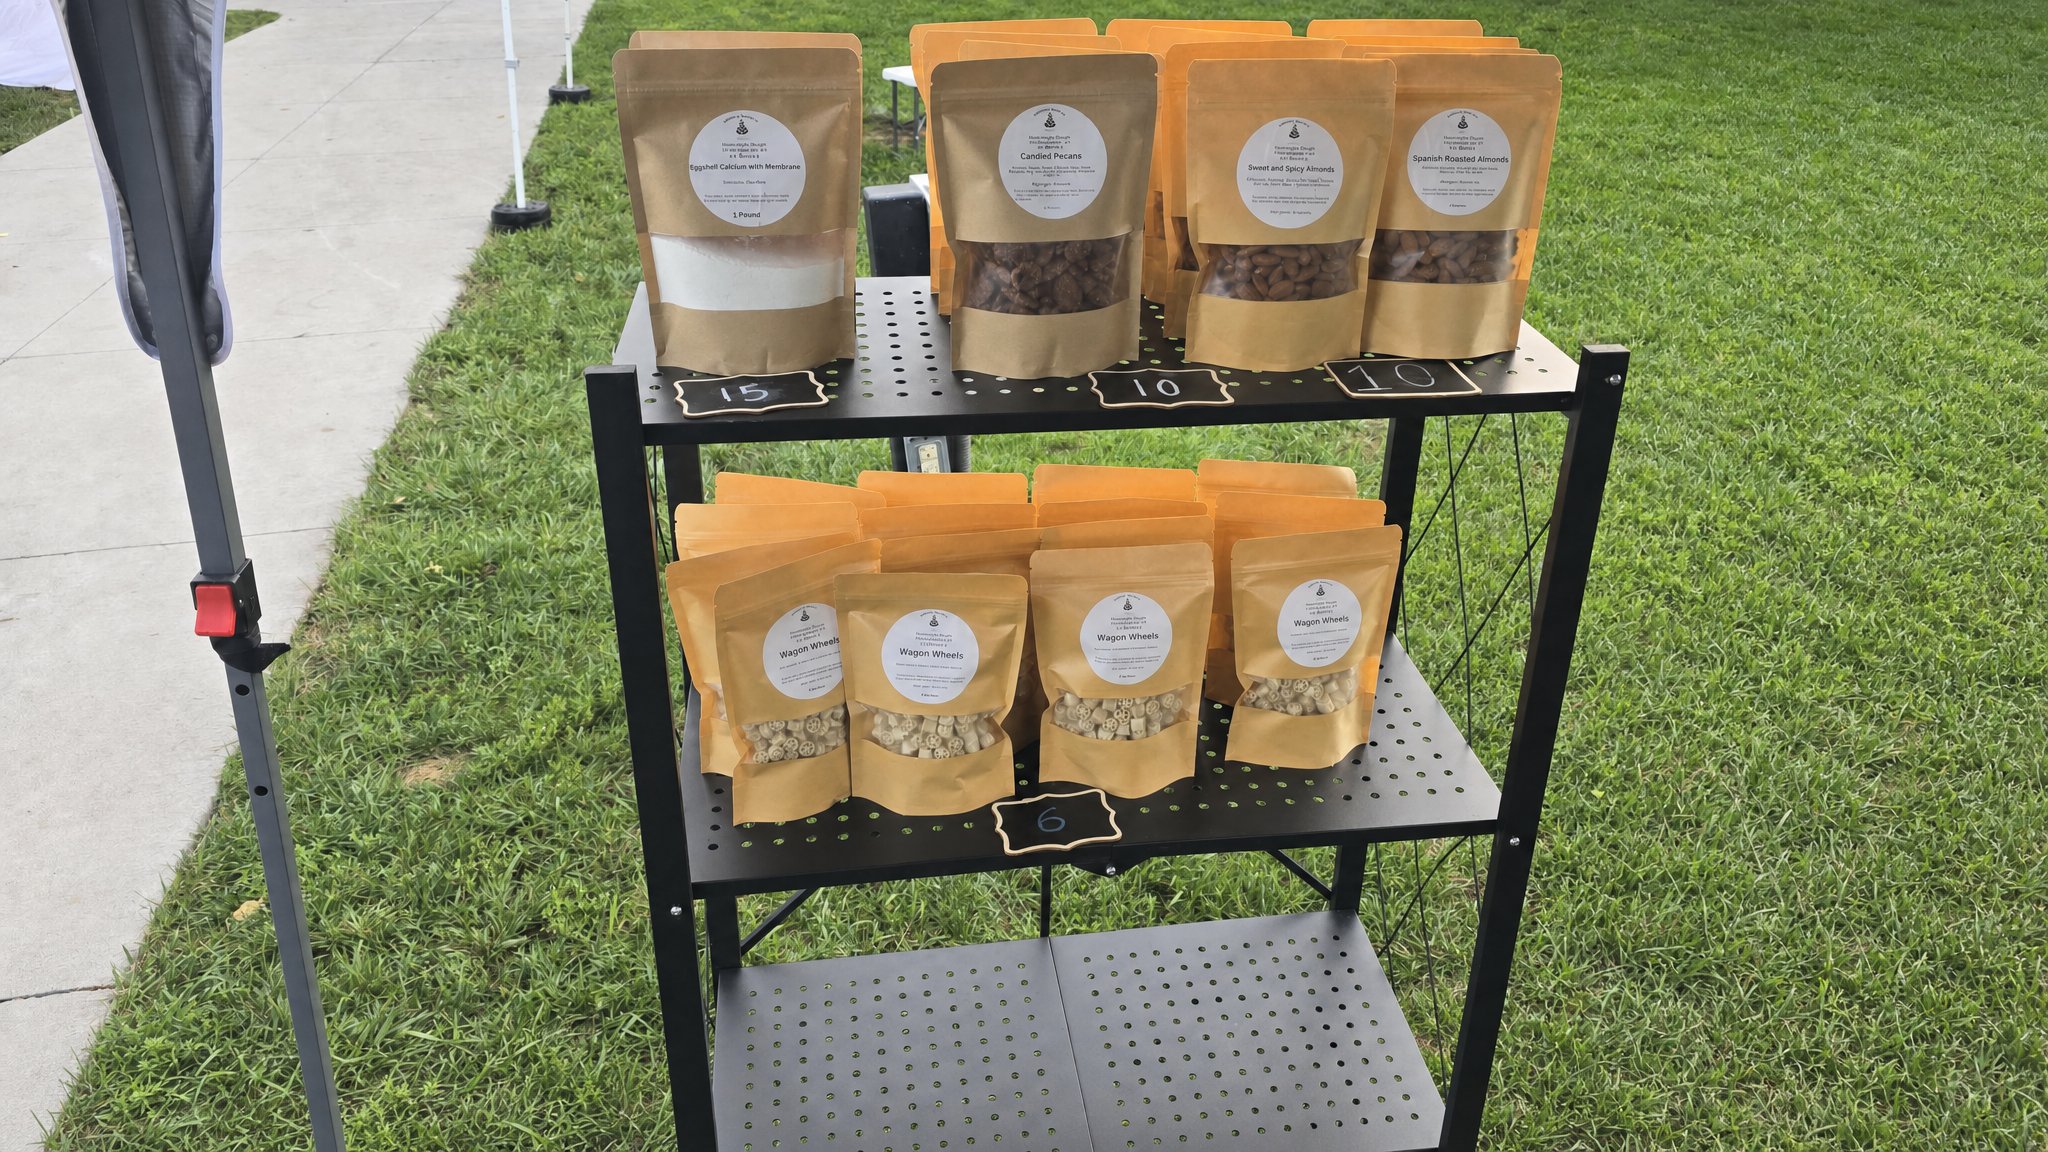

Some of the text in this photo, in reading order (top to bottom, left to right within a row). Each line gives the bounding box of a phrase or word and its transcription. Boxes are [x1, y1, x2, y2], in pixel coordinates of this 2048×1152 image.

[1133, 378, 1181, 397] 10
[1347, 363, 1435, 393] 10
[721, 382, 769, 402] 15
[1294, 616, 1349, 627] Wagon Wheels
[780, 636, 840, 659] Wagon Wheels
[1097, 634, 1126, 643] Wagon
[900, 648, 964, 660] Wagon Wheels
[1038, 807, 1066, 832] 6
